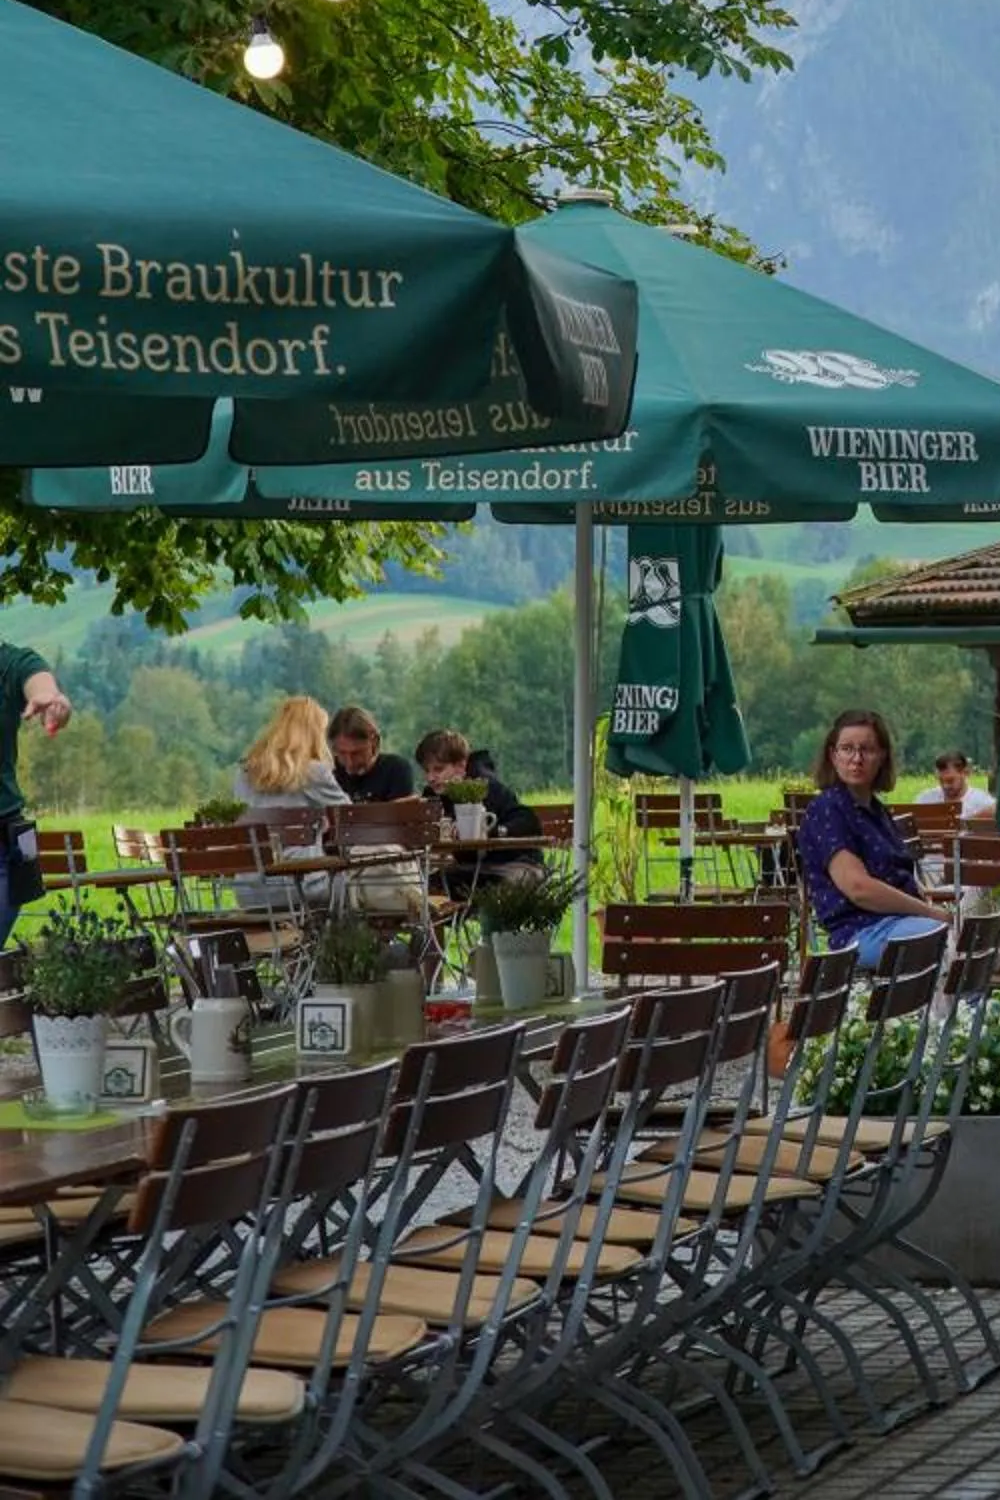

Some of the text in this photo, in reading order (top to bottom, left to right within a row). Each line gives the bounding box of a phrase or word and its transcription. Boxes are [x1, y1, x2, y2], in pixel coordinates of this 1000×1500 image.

[0, 228, 404, 309] ste Braukultur
[35, 311, 347, 377] Teisendorf.
[806, 425, 979, 463] WIENINGER
[110, 466, 155, 495] BIER
[355, 460, 598, 492] aus Teisendorf.
[859, 461, 931, 494] BIER
[613, 708, 661, 736] BIER
